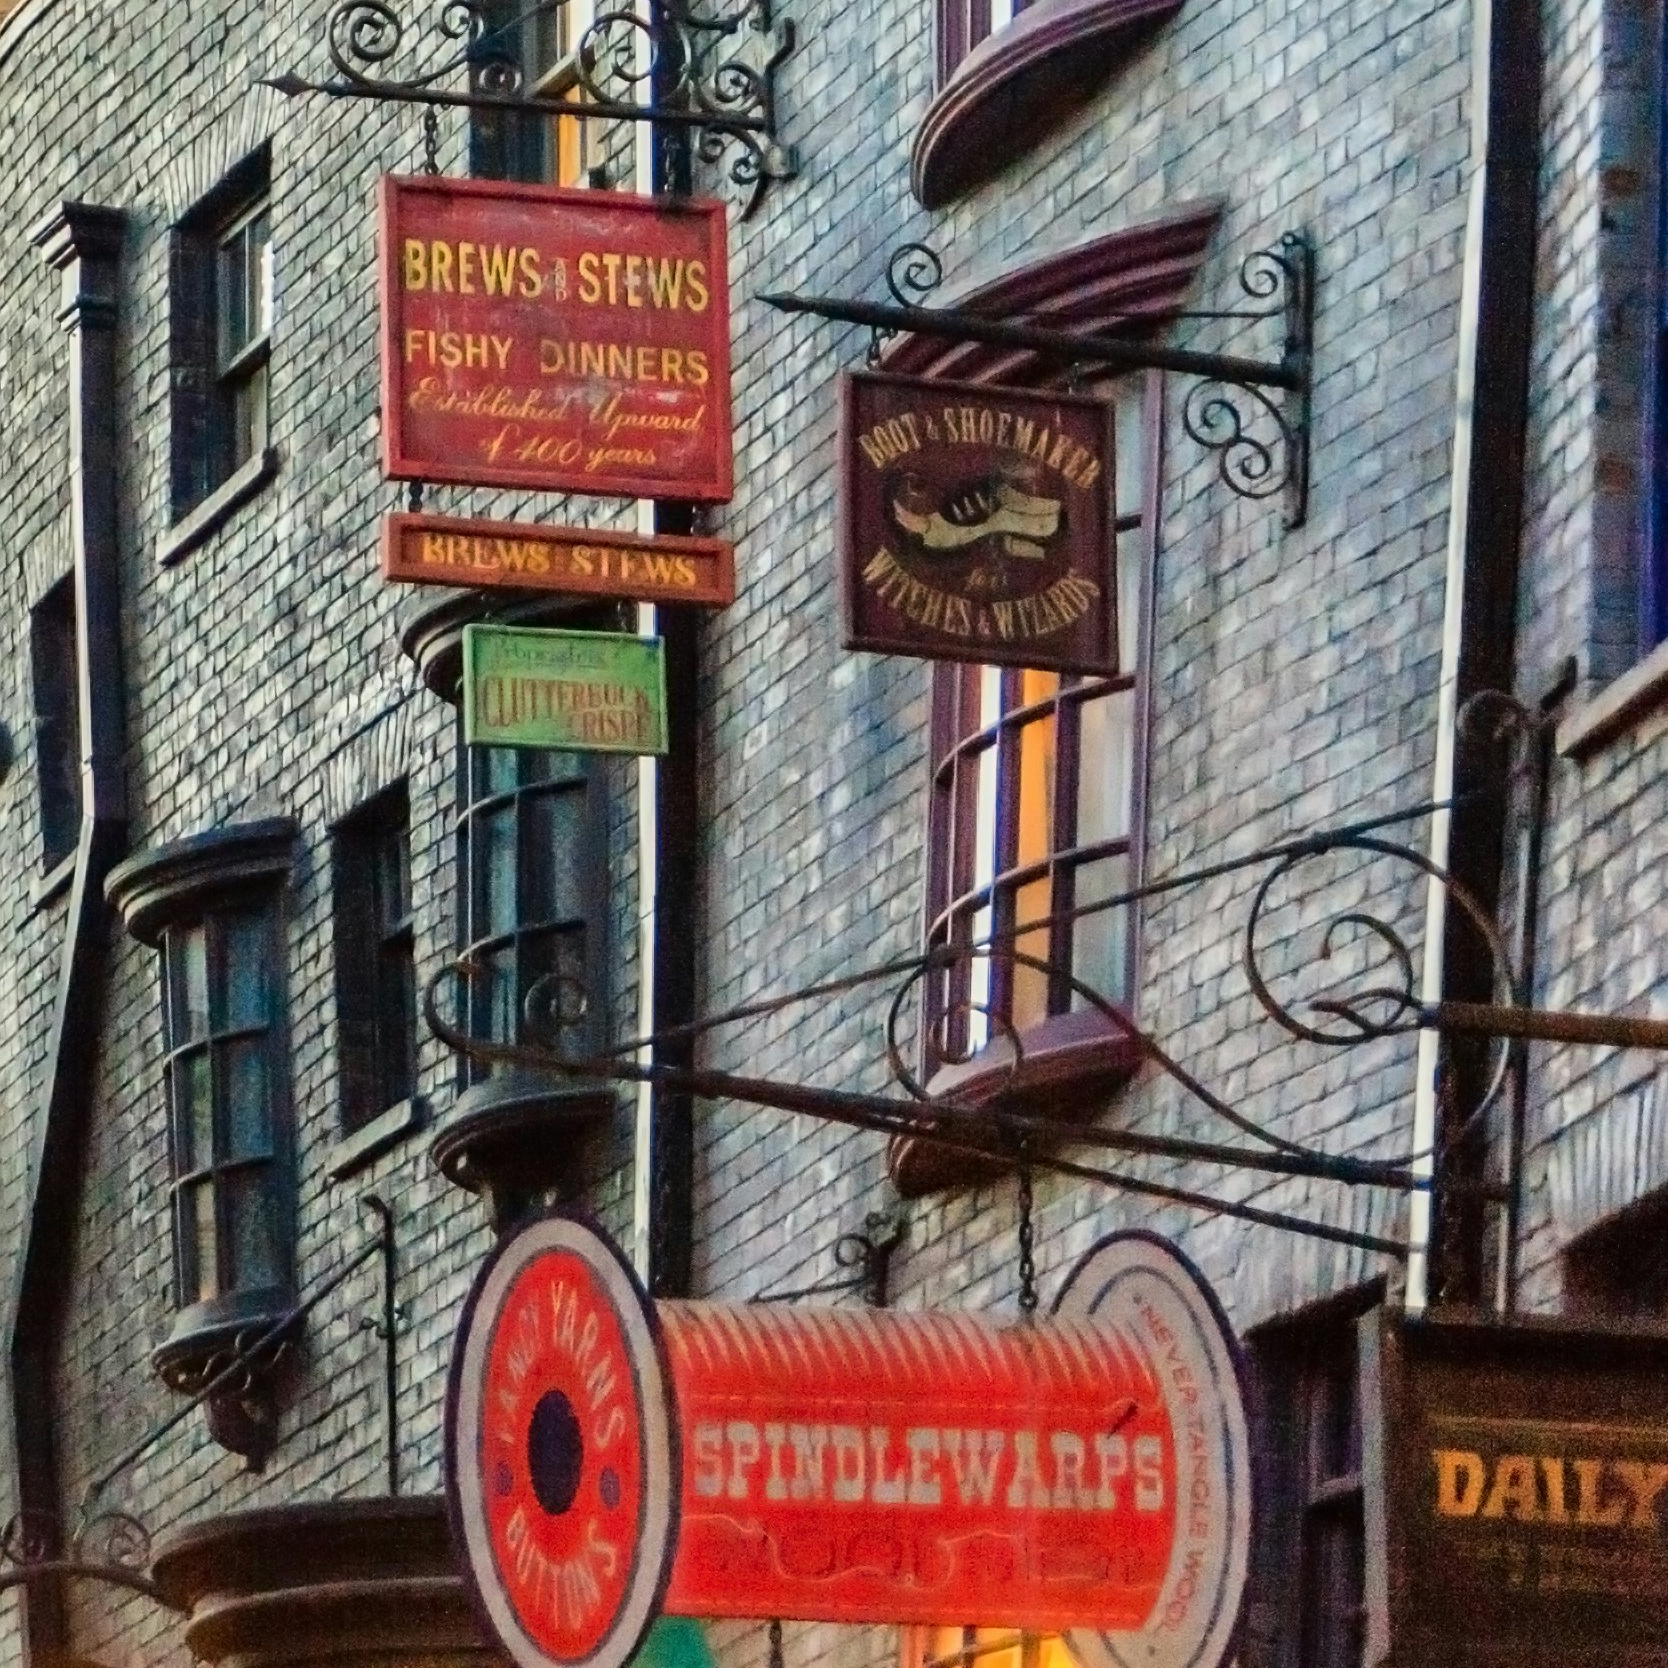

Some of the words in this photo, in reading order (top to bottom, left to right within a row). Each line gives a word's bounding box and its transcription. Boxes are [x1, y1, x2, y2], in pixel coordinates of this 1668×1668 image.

[404, 240, 540, 298] BREWS
[578, 252, 709, 312] STEWS
[405, 330, 513, 369] FISHY
[539, 340, 710, 384] DINNERS
[408, 376, 571, 422] Established
[582, 444, 656, 472] years
[860, 413, 922, 468] BOOT
[944, 407, 1102, 489] SHOEMAKER
[422, 535, 551, 573] BREWS
[571, 544, 697, 587] STEWS
[550, 1280, 626, 1451] YARNS
[694, 1420, 1164, 1512] SPINDLEWARPS
[1432, 1449, 1668, 1528] DAILY
